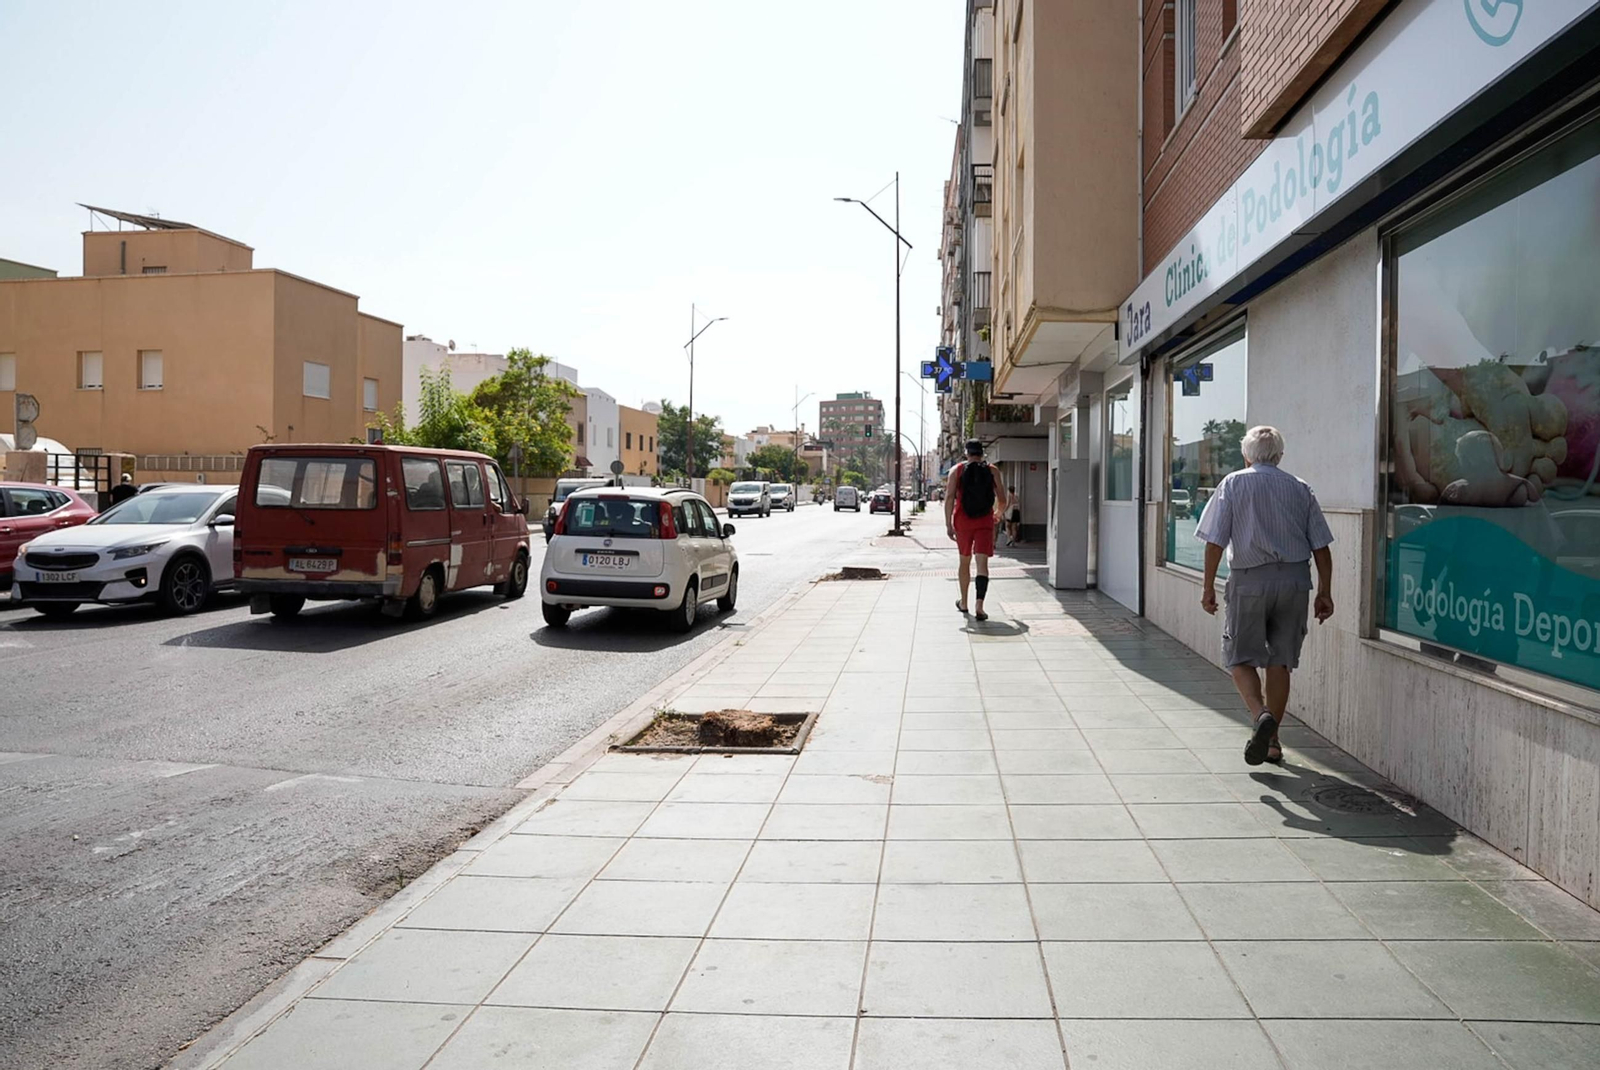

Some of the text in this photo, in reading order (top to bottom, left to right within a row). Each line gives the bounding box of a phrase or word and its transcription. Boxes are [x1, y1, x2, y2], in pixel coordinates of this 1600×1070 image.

[1127, 301, 1151, 347] Jara
[1217, 215, 1236, 267] de
[1242, 82, 1381, 245] Podología
[42, 572, 60, 581] 1302
[588, 555, 631, 566] 0120 LBJ
[1401, 573, 1505, 637] Podología
